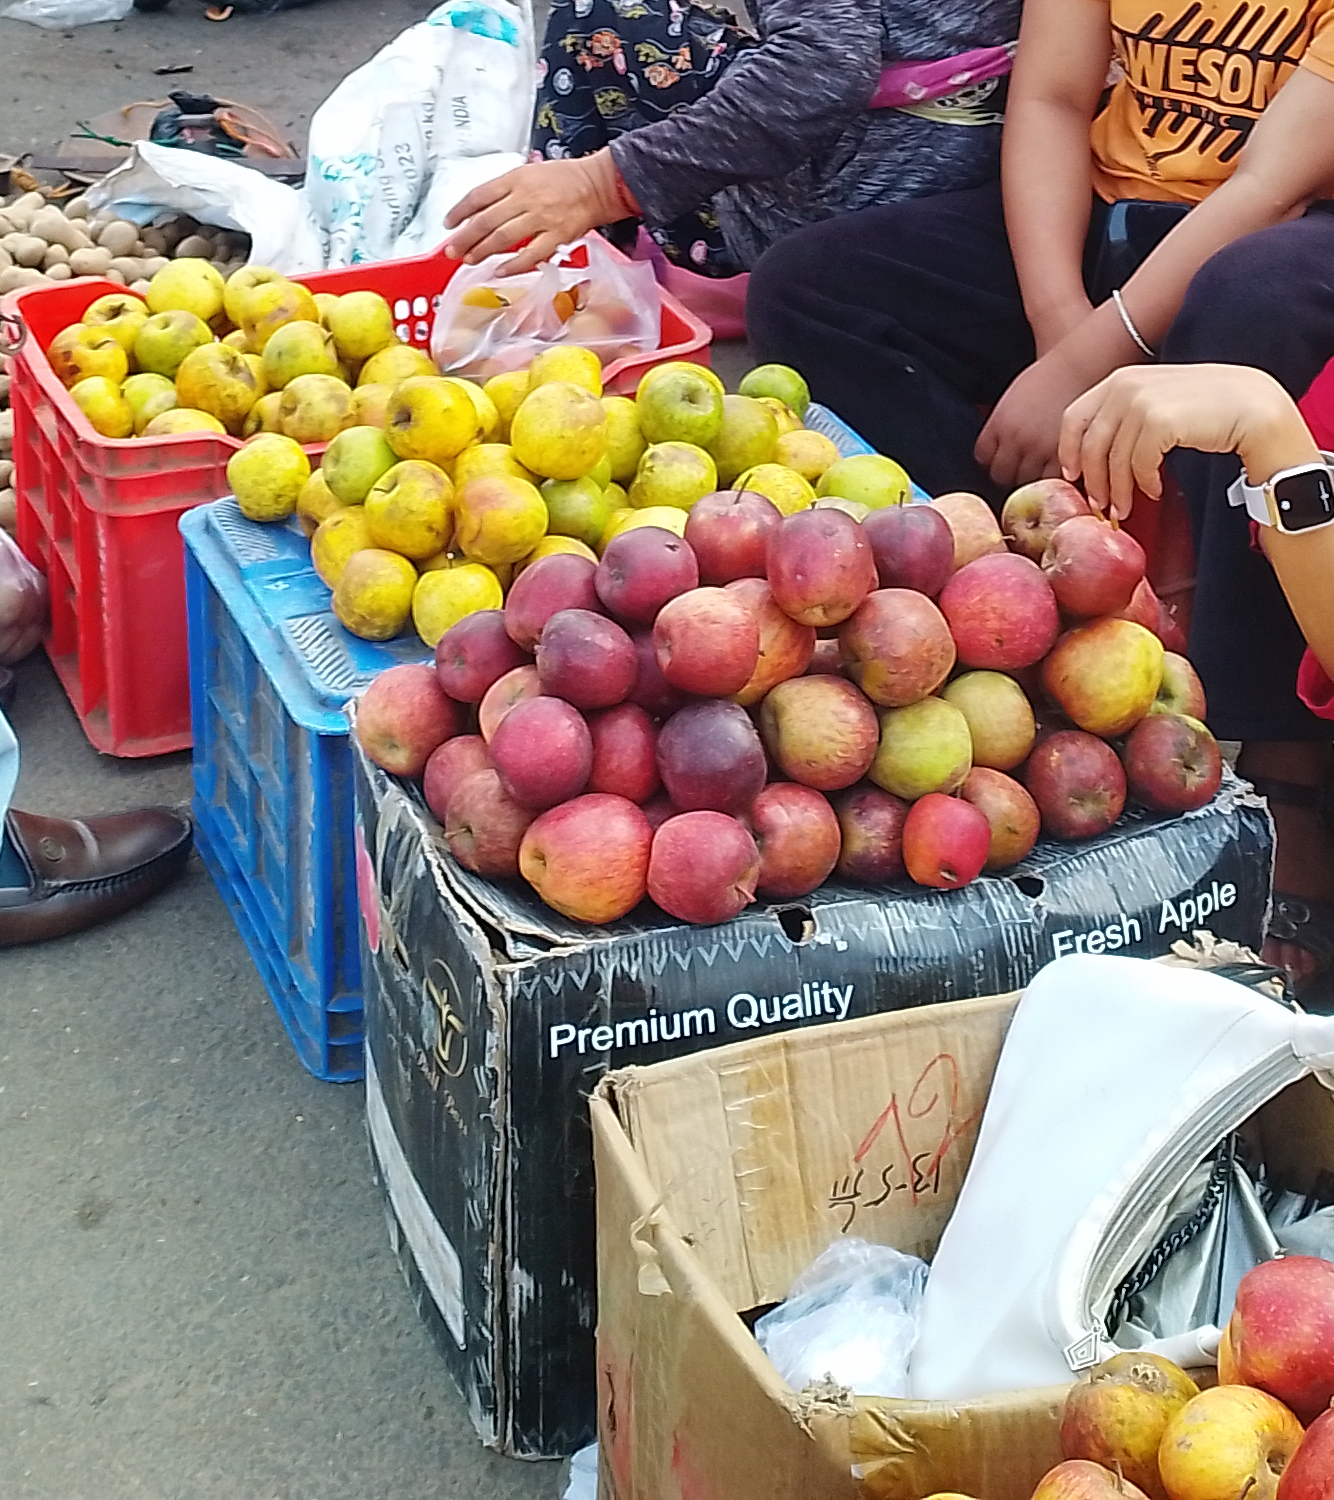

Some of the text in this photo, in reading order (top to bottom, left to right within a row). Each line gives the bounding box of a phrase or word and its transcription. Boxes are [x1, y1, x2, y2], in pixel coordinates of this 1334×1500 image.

[1051, 880, 1238, 959] Fresh Apple
[549, 980, 855, 1059] Premium Quality
